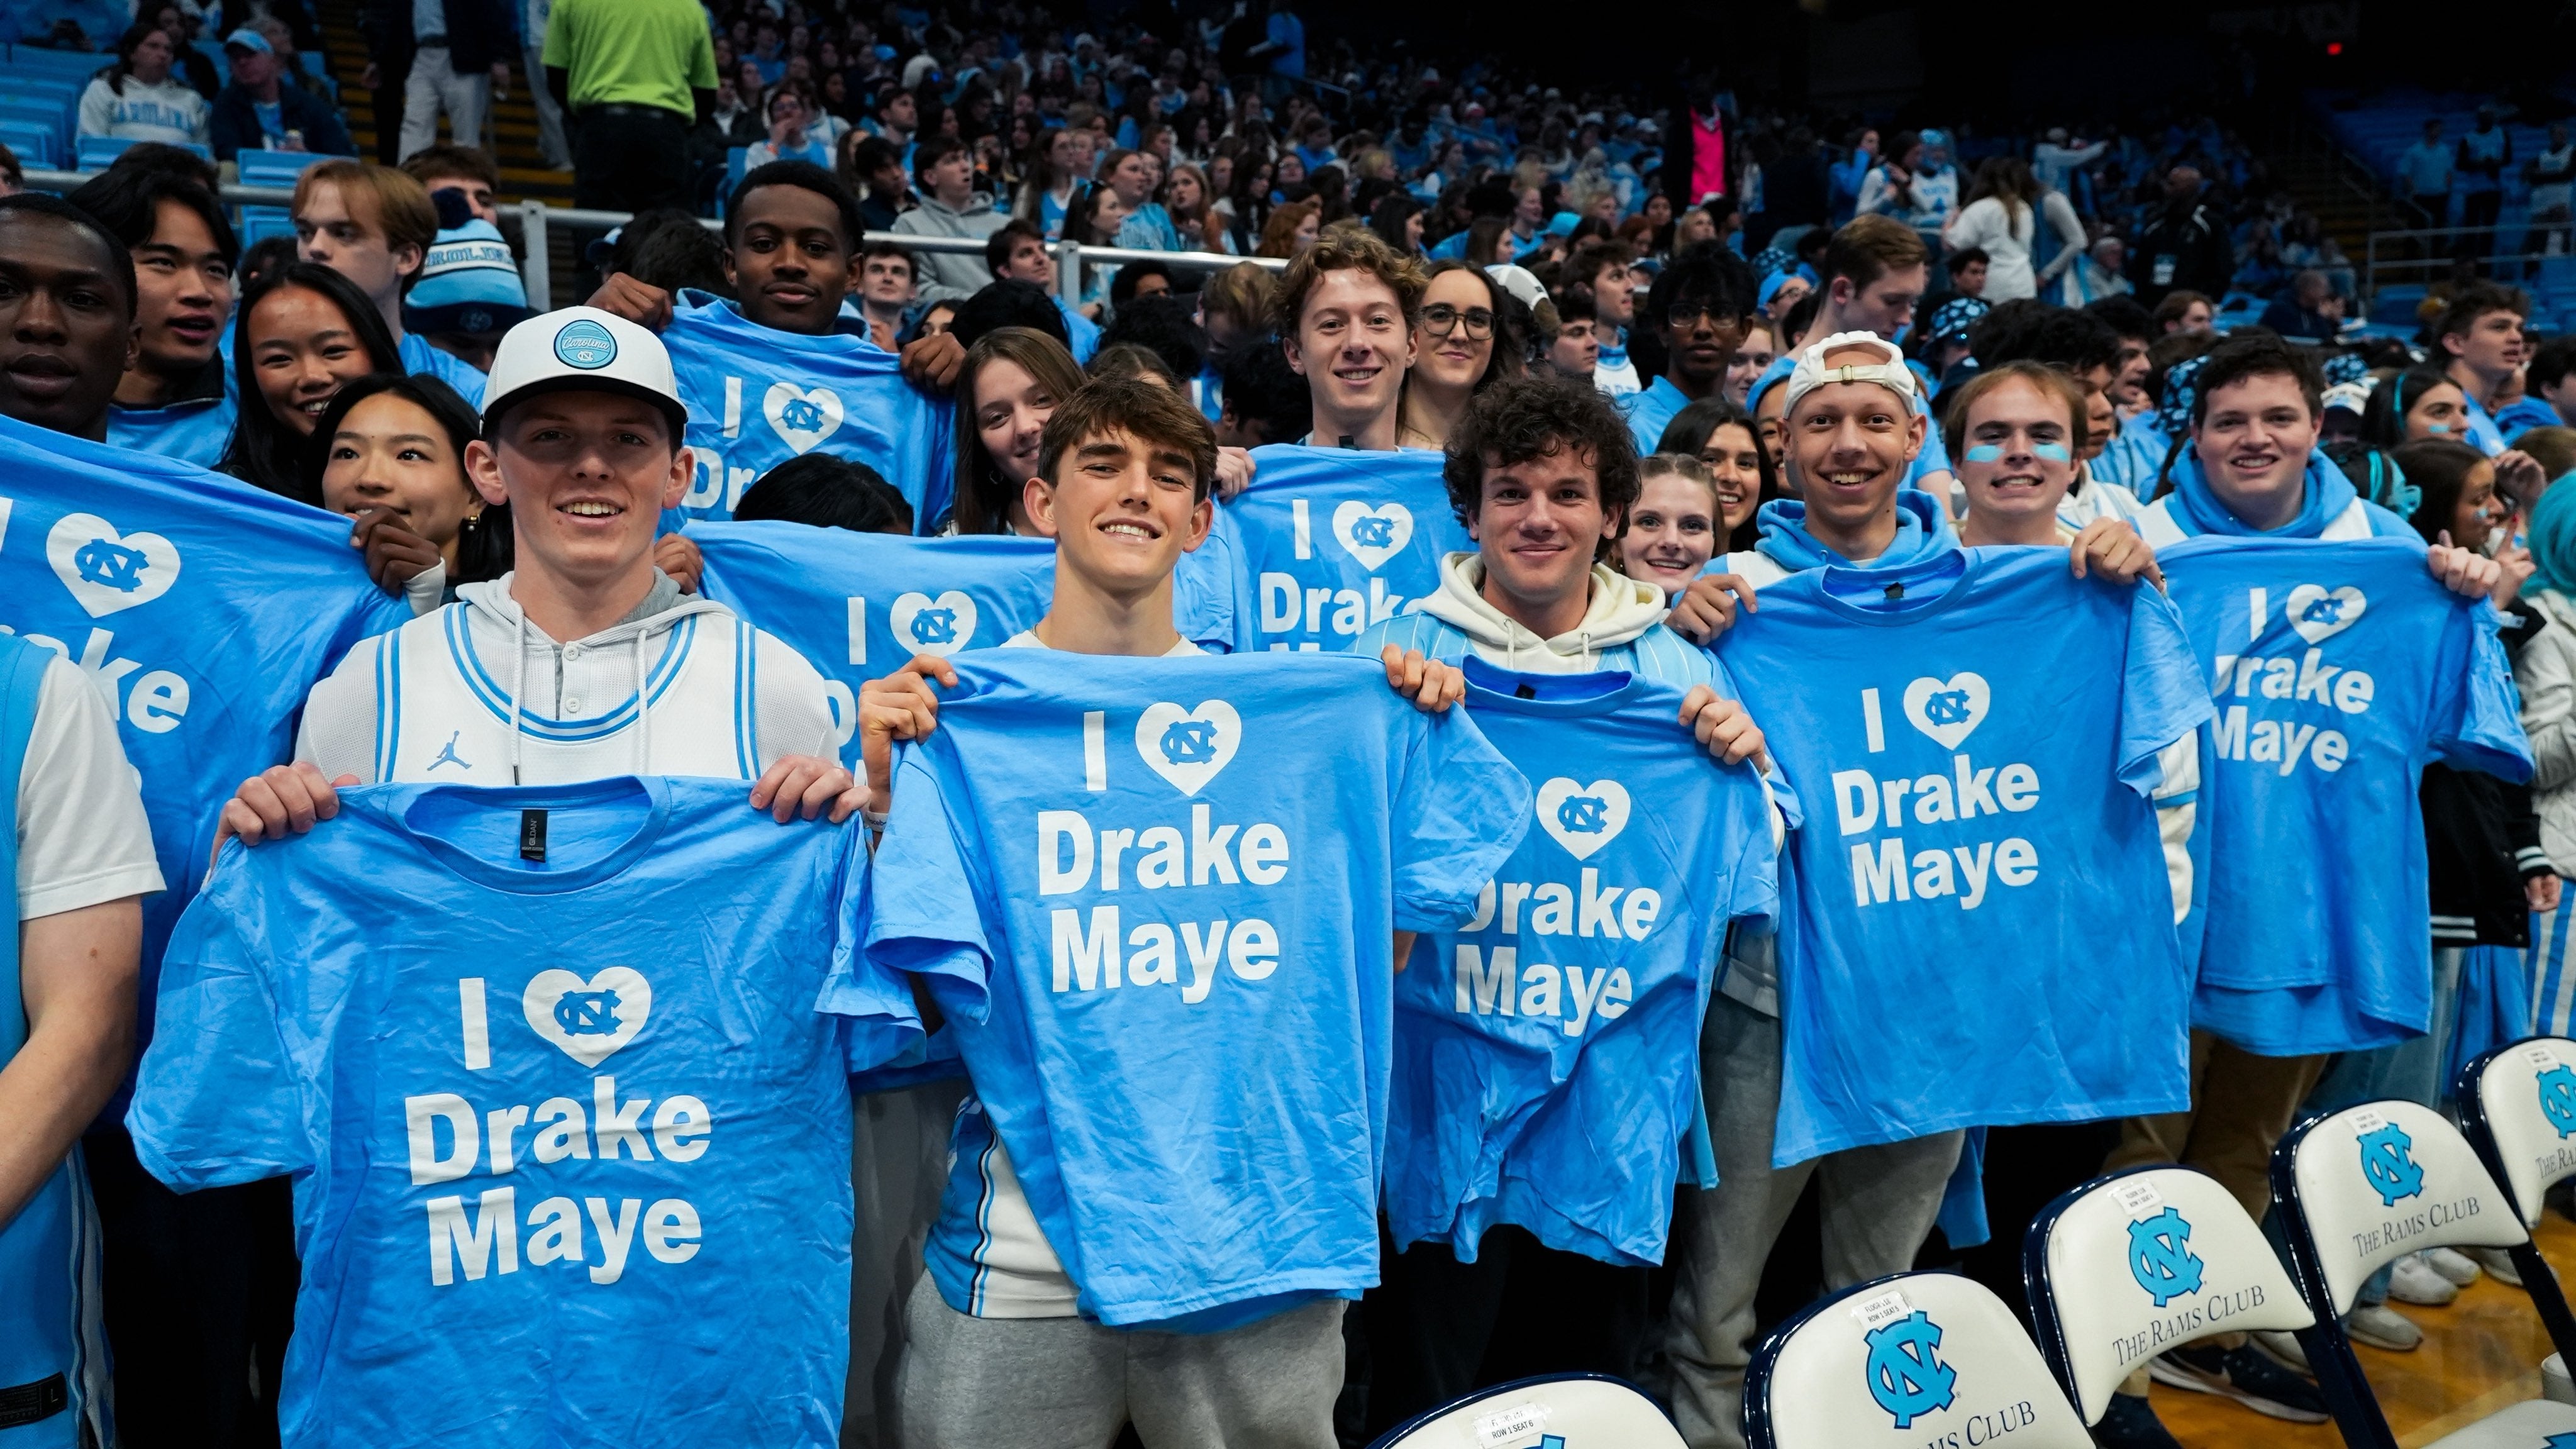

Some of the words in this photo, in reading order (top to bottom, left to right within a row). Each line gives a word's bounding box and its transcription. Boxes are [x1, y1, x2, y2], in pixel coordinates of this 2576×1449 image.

[563, 337, 610, 350] Carolina
[723, 376, 742, 438] I
[1292, 499, 1311, 560] I
[848, 596, 866, 665] I
[2249, 587, 2267, 643] I
[1084, 711, 1108, 792] I
[1862, 688, 1884, 753] I
[2211, 705, 2349, 777] Maye
[1831, 754, 2040, 836] Drake
[529, 820, 537, 846] GILDAN
[1038, 804, 1289, 896] Drake
[1851, 838, 2038, 910] Maye
[1051, 905, 1280, 1004] Maye
[459, 977, 491, 1070] I
[1456, 944, 1633, 1036] Maye
[405, 1075, 712, 1186] Drake
[426, 1186, 702, 1286] Maye
[2353, 1230, 2381, 1258] THE
[2382, 1213, 2425, 1245] RAMS
[2429, 1196, 2480, 1228] CLUB
[2112, 1330, 2148, 1367] THE
[2150, 1307, 2202, 1347] RAMS
[2207, 1285, 2265, 1321] CLUB
[50, 1388, 59, 1403] L
[1491, 1428, 1507, 1440] ROW
[1507, 1426, 1513, 1435] 1
[1513, 1421, 1529, 1433] SEAT
[1967, 1401, 2036, 1446] CLUB
